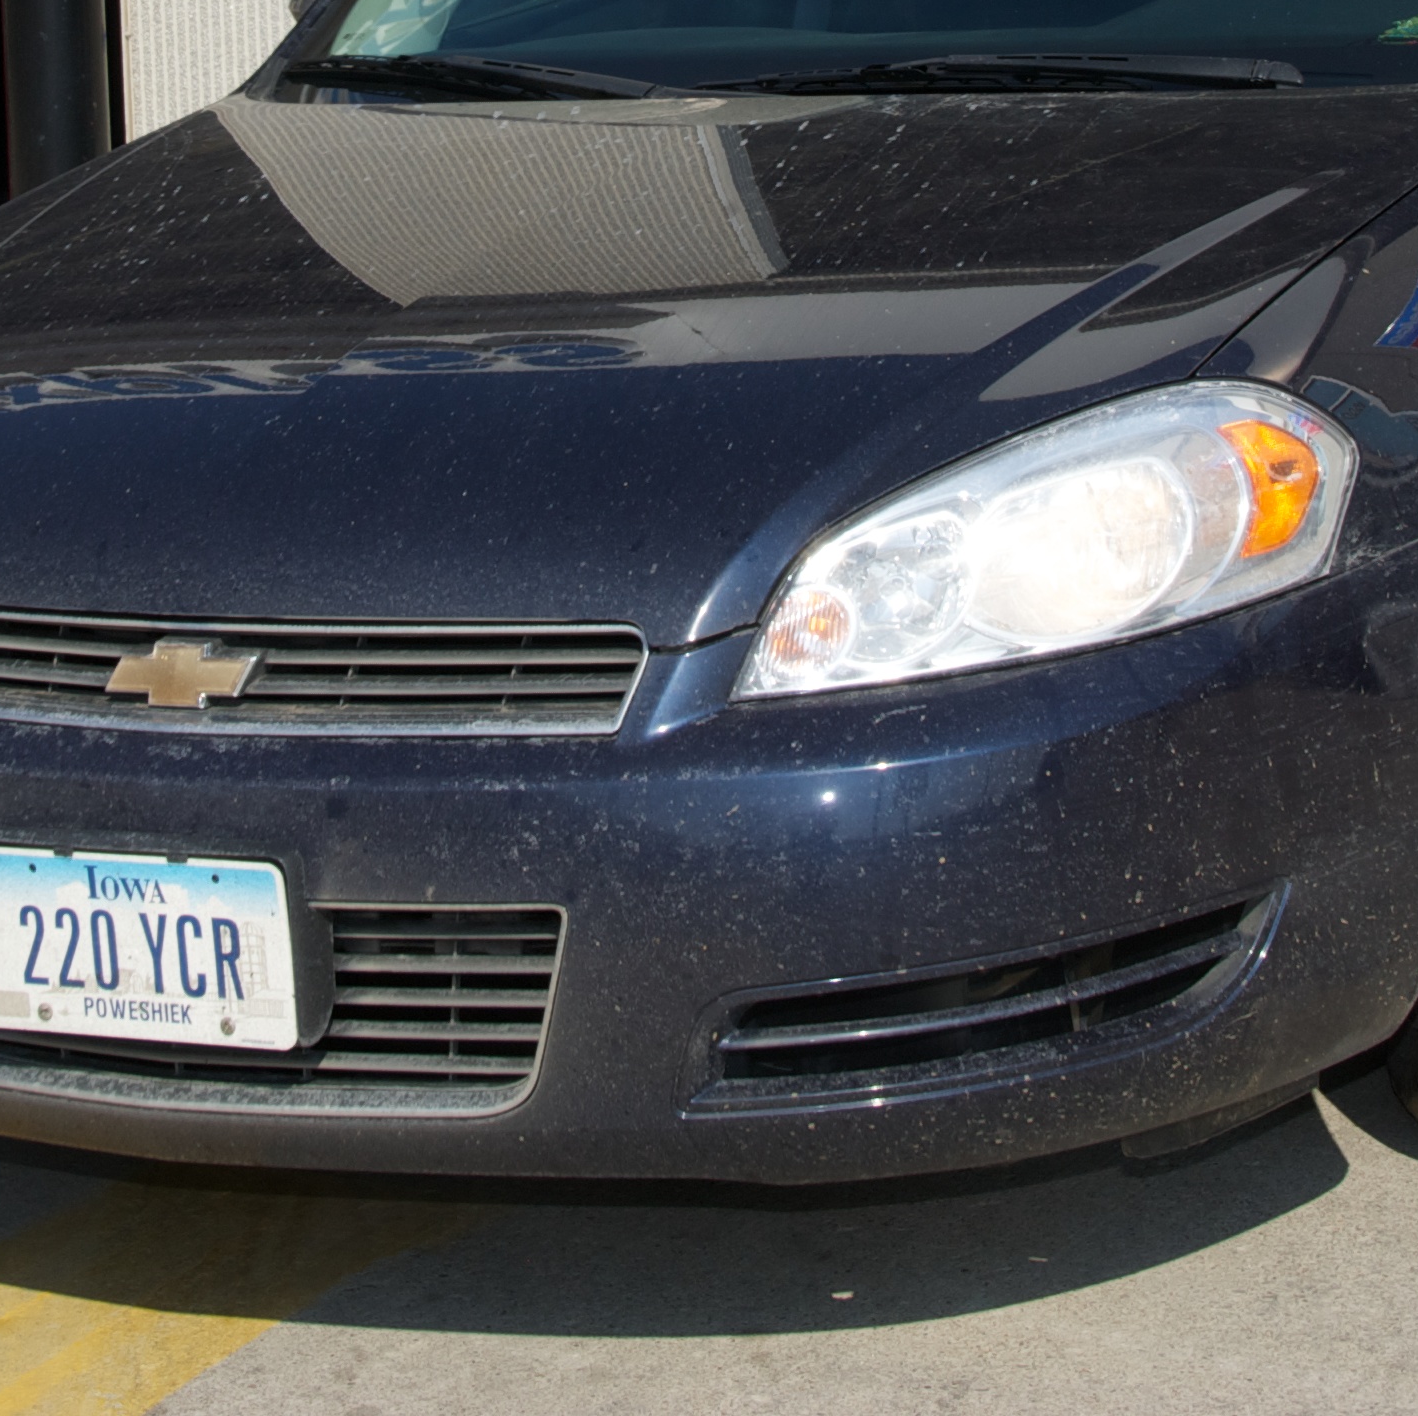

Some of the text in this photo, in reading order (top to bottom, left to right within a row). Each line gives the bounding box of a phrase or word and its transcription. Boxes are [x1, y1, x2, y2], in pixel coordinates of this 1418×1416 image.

[19, 904, 245, 1001] 220 YCR
[84, 996, 193, 1025] POWESHIEK
